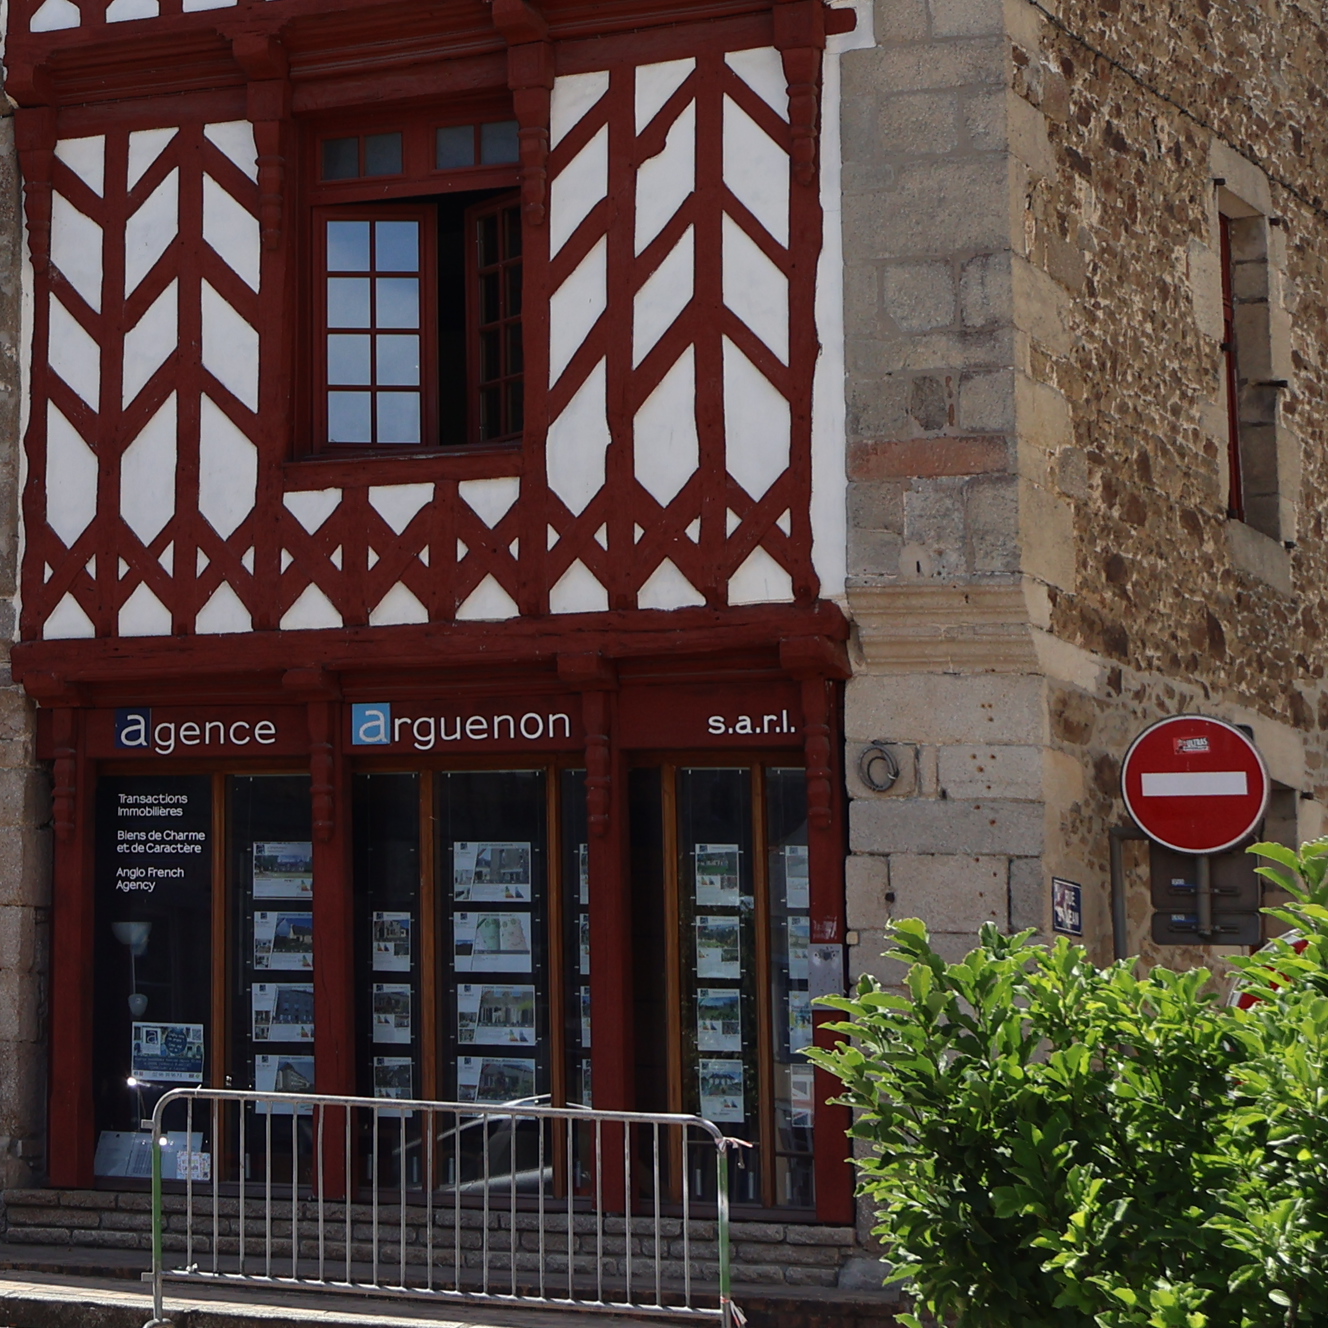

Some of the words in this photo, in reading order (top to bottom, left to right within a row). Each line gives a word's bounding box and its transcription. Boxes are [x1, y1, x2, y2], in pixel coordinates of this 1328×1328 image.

[120, 714, 276, 755] agence
[359, 709, 570, 750] arguenon
[708, 709, 796, 735] s.a.r.l.
[118, 793, 188, 804] Transactions
[117, 806, 183, 817] Immobilières
[117, 830, 146, 840] Biens
[148, 830, 162, 840] de
[163, 830, 206, 840] Charme
[116, 843, 130, 853] et
[131, 842, 144, 853] de
[146, 842, 202, 853] Caractère
[116, 867, 146, 880] Anglo
[147, 867, 184, 878] French
[116, 880, 156, 892] Agency
